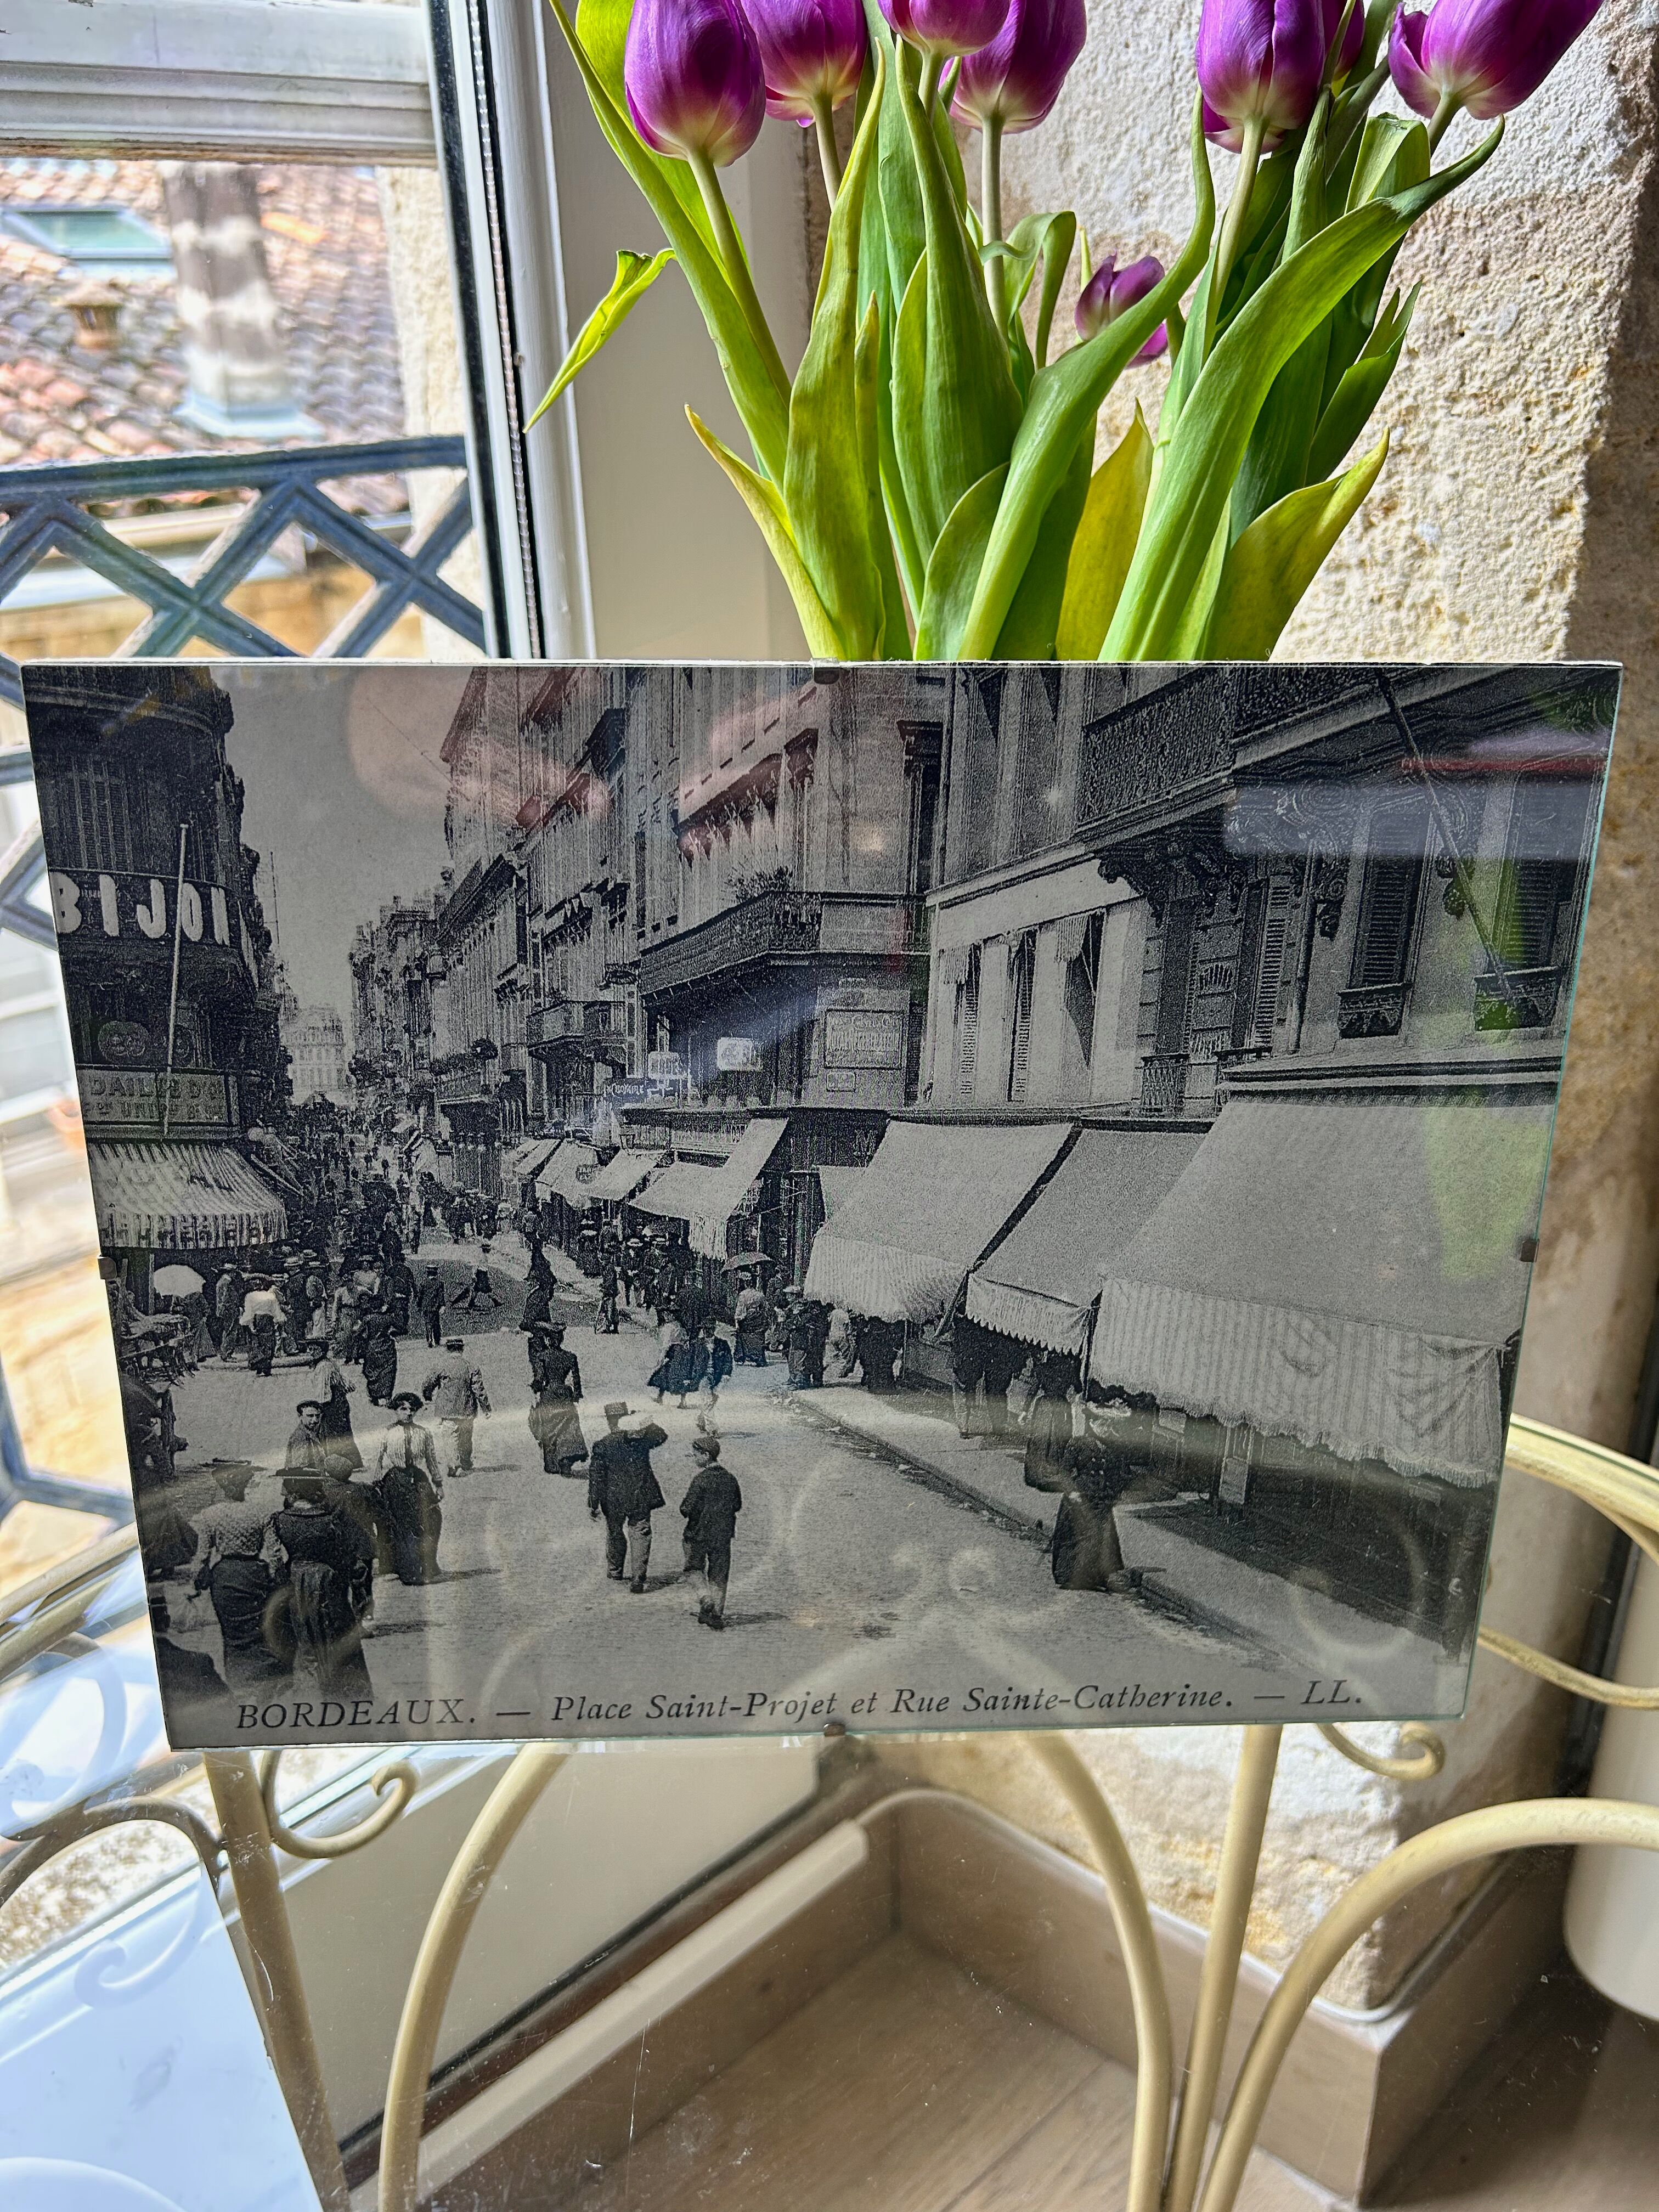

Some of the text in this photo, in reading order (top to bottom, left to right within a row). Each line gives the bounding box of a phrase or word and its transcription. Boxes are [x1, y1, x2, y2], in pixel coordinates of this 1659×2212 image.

[236, 1699, 475, 1729] BORDEAUX.
[551, 1696, 632, 1721] Place
[645, 1691, 838, 1723] Saint-Projet
[851, 1692, 878, 1714] et
[886, 1689, 950, 1713] Rue
[962, 1683, 1233, 1712] Sainte-Catherine.
[1301, 1679, 1362, 1705] LL.
